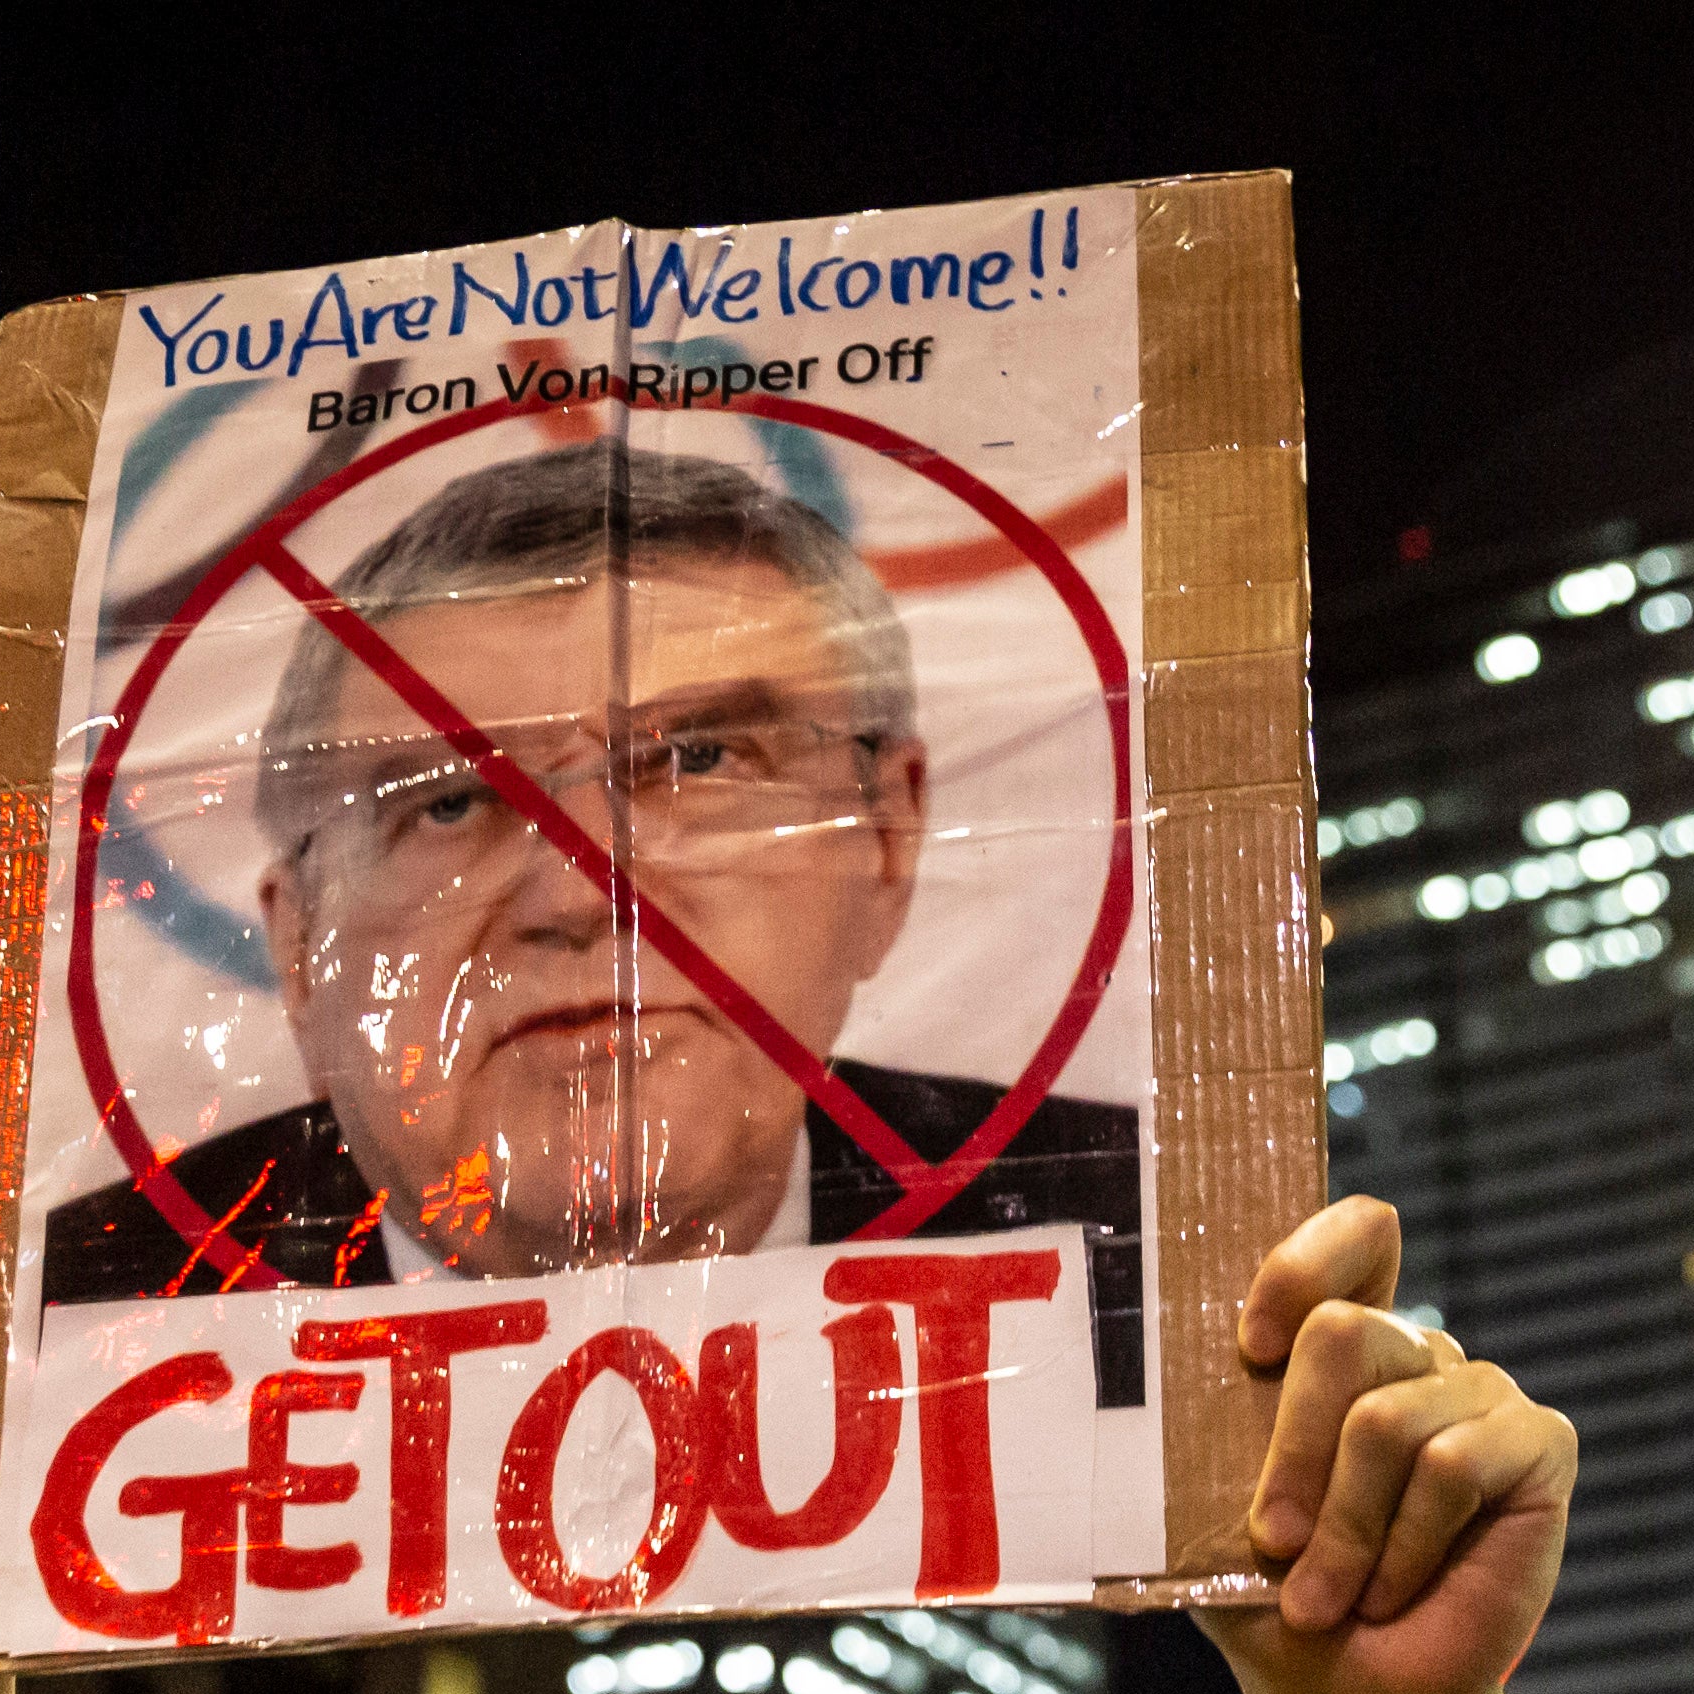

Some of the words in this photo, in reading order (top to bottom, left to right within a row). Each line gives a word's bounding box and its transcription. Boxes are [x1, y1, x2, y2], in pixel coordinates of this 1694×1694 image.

[139, 292, 284, 388] You
[286, 272, 439, 377] Are
[448, 251, 618, 338] Not
[306, 372, 476, 433] Baron
[497, 362, 609, 405] Von
[628, 356, 820, 409] Ripper
[836, 336, 934, 385] Off
[30, 1299, 551, 1647] GET
[494, 1248, 1061, 1613] OUT
